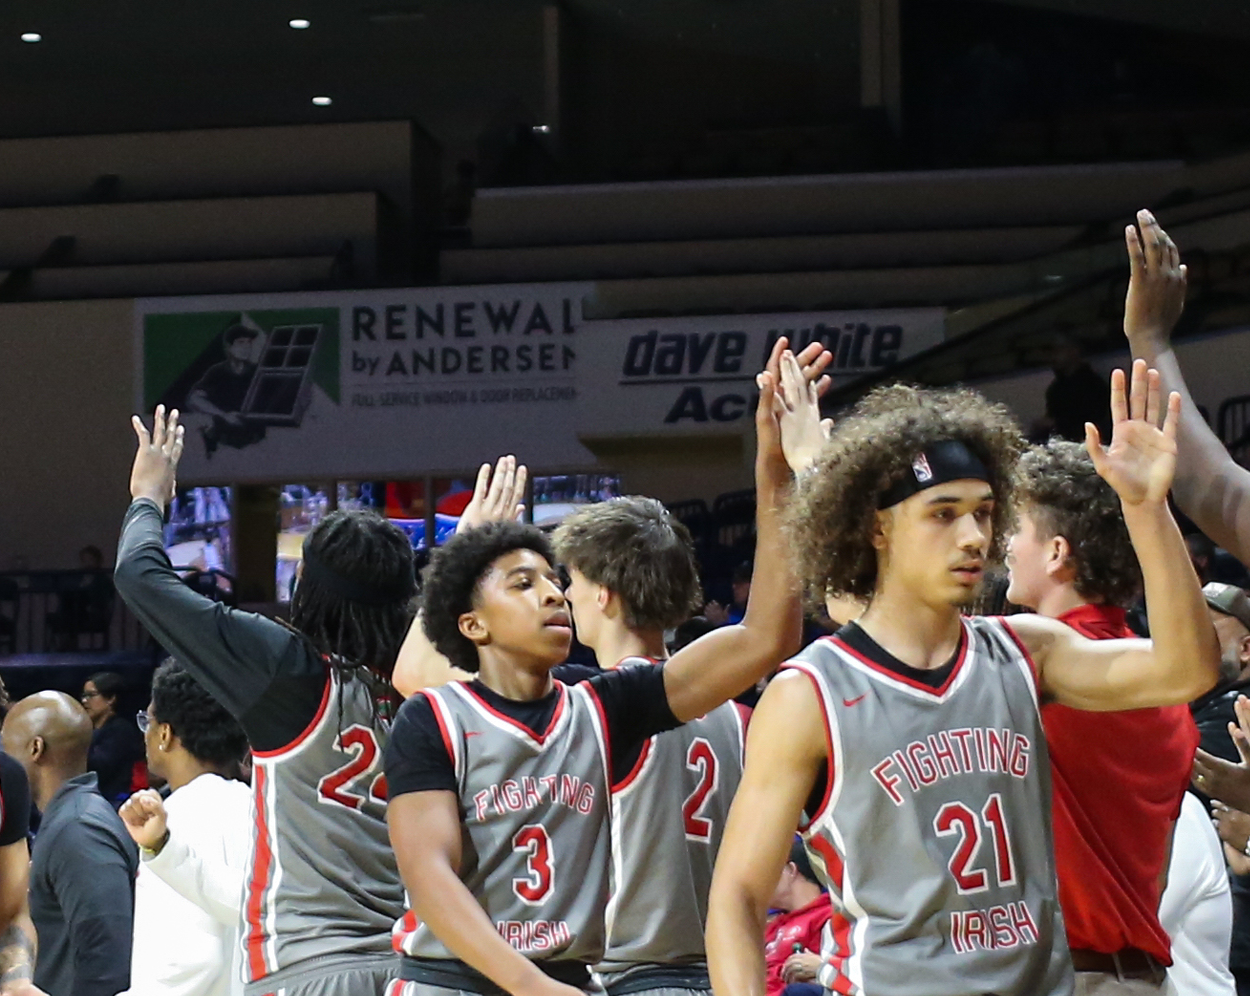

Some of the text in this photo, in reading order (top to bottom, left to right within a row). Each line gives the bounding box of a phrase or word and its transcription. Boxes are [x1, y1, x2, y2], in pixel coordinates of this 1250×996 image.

[352, 299, 575, 341] RENEWAL
[622, 329, 747, 376] dave
[352, 351, 379, 376] by
[316, 722, 388, 810] 2
[473, 774, 595, 822] FIGHTNG
[682, 736, 720, 844] 2
[869, 727, 1030, 806] FIGHTING
[511, 823, 556, 907] 3
[933, 792, 1018, 896] 21
[950, 900, 1040, 955] IRISH
